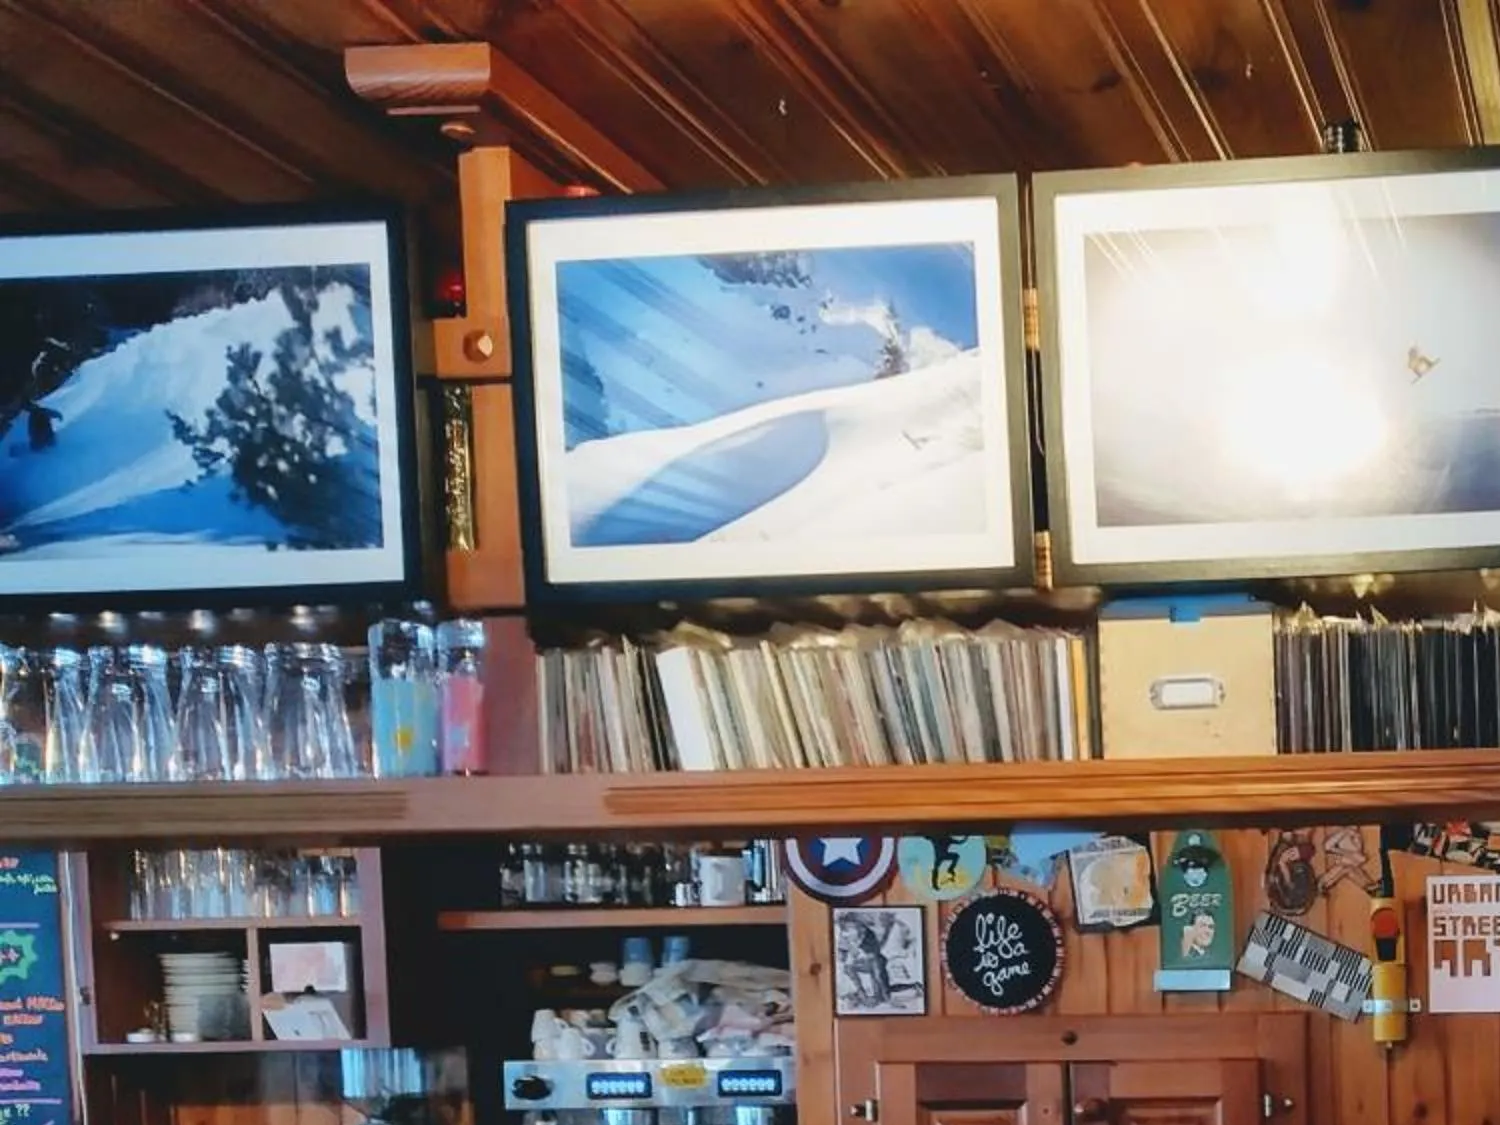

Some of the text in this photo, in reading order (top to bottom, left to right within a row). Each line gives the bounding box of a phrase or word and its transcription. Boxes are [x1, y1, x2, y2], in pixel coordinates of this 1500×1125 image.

[1171, 893, 1223, 918] BEER
[972, 912, 1024, 960] life
[1012, 941, 1031, 957] a
[982, 960, 1032, 996] game
